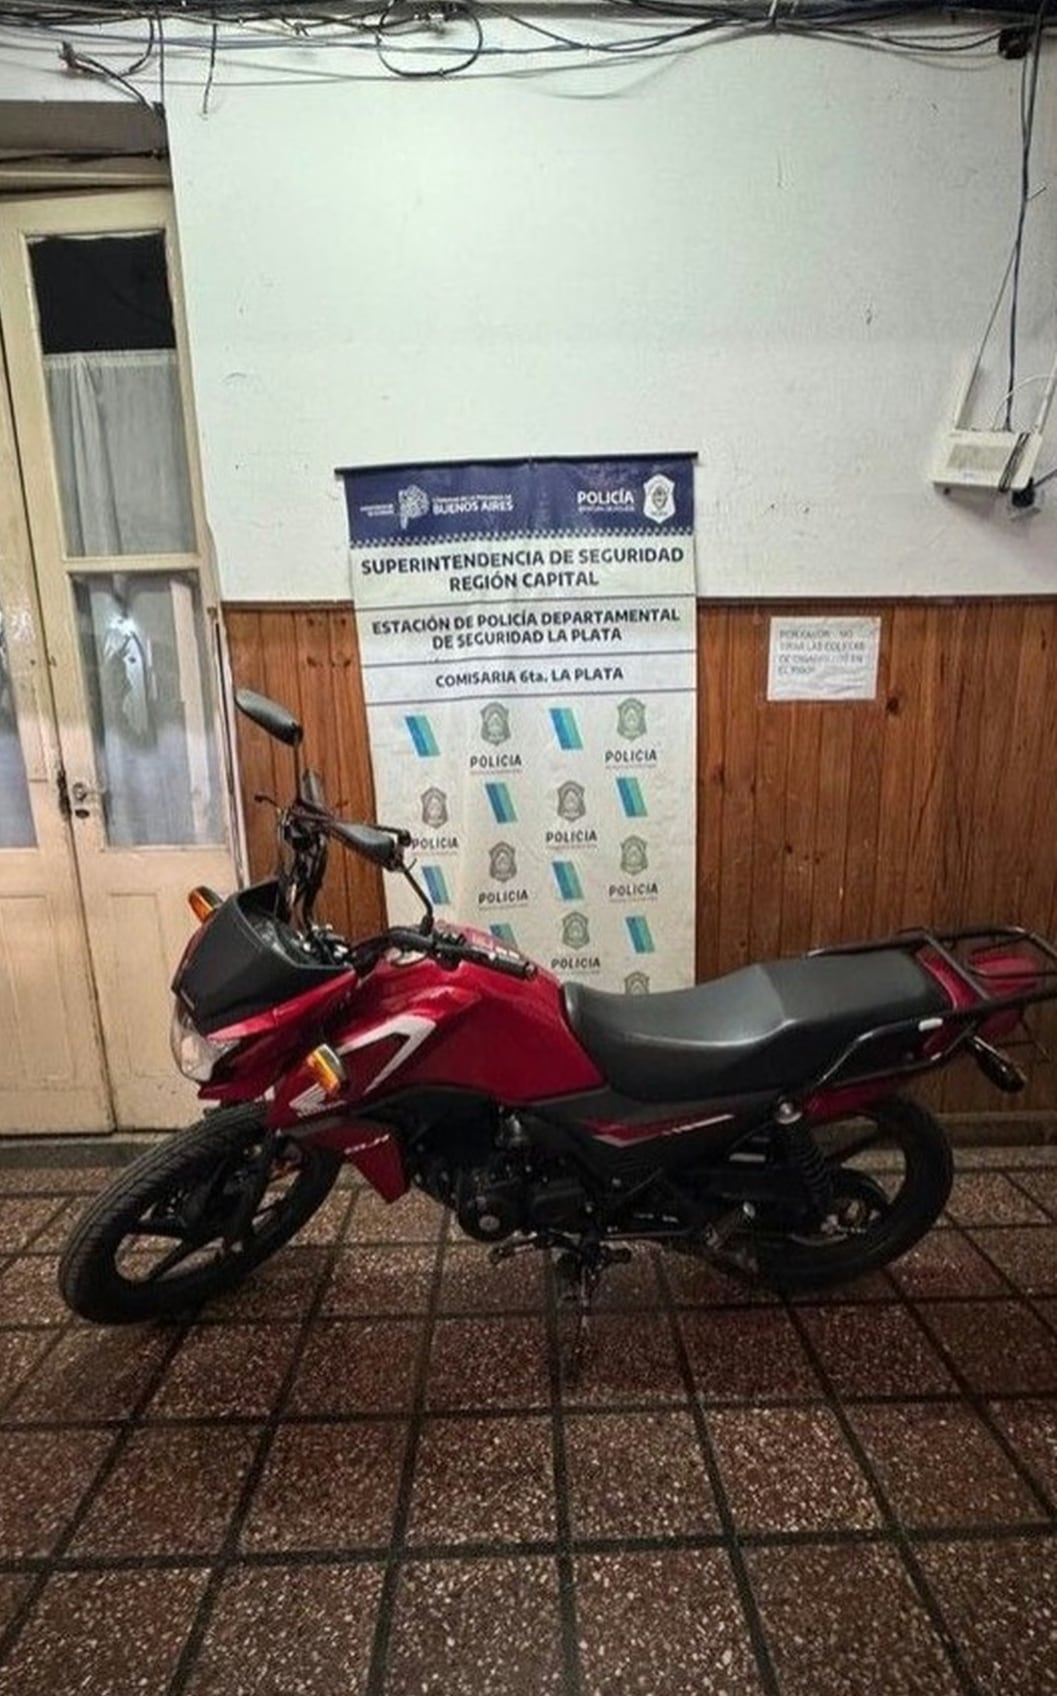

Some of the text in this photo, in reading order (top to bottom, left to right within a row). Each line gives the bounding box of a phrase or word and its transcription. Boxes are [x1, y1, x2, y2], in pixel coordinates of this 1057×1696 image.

[577, 488, 634, 504] POLICÍA
[433, 500, 514, 515] BUENOS AIRES
[361, 547, 684, 575] SUPERINTENDENCIA DE SEGURIDAD
[449, 571, 600, 592] REGIÓN CAPITAL
[372, 608, 681, 635] ESTACIÓN DE POLICÍA DEPARTAMENTAL
[432, 627, 622, 650] DE SEGURIDAD LA PLATA
[435, 667, 624, 688] COMISARIA 6ta. LA PLATA
